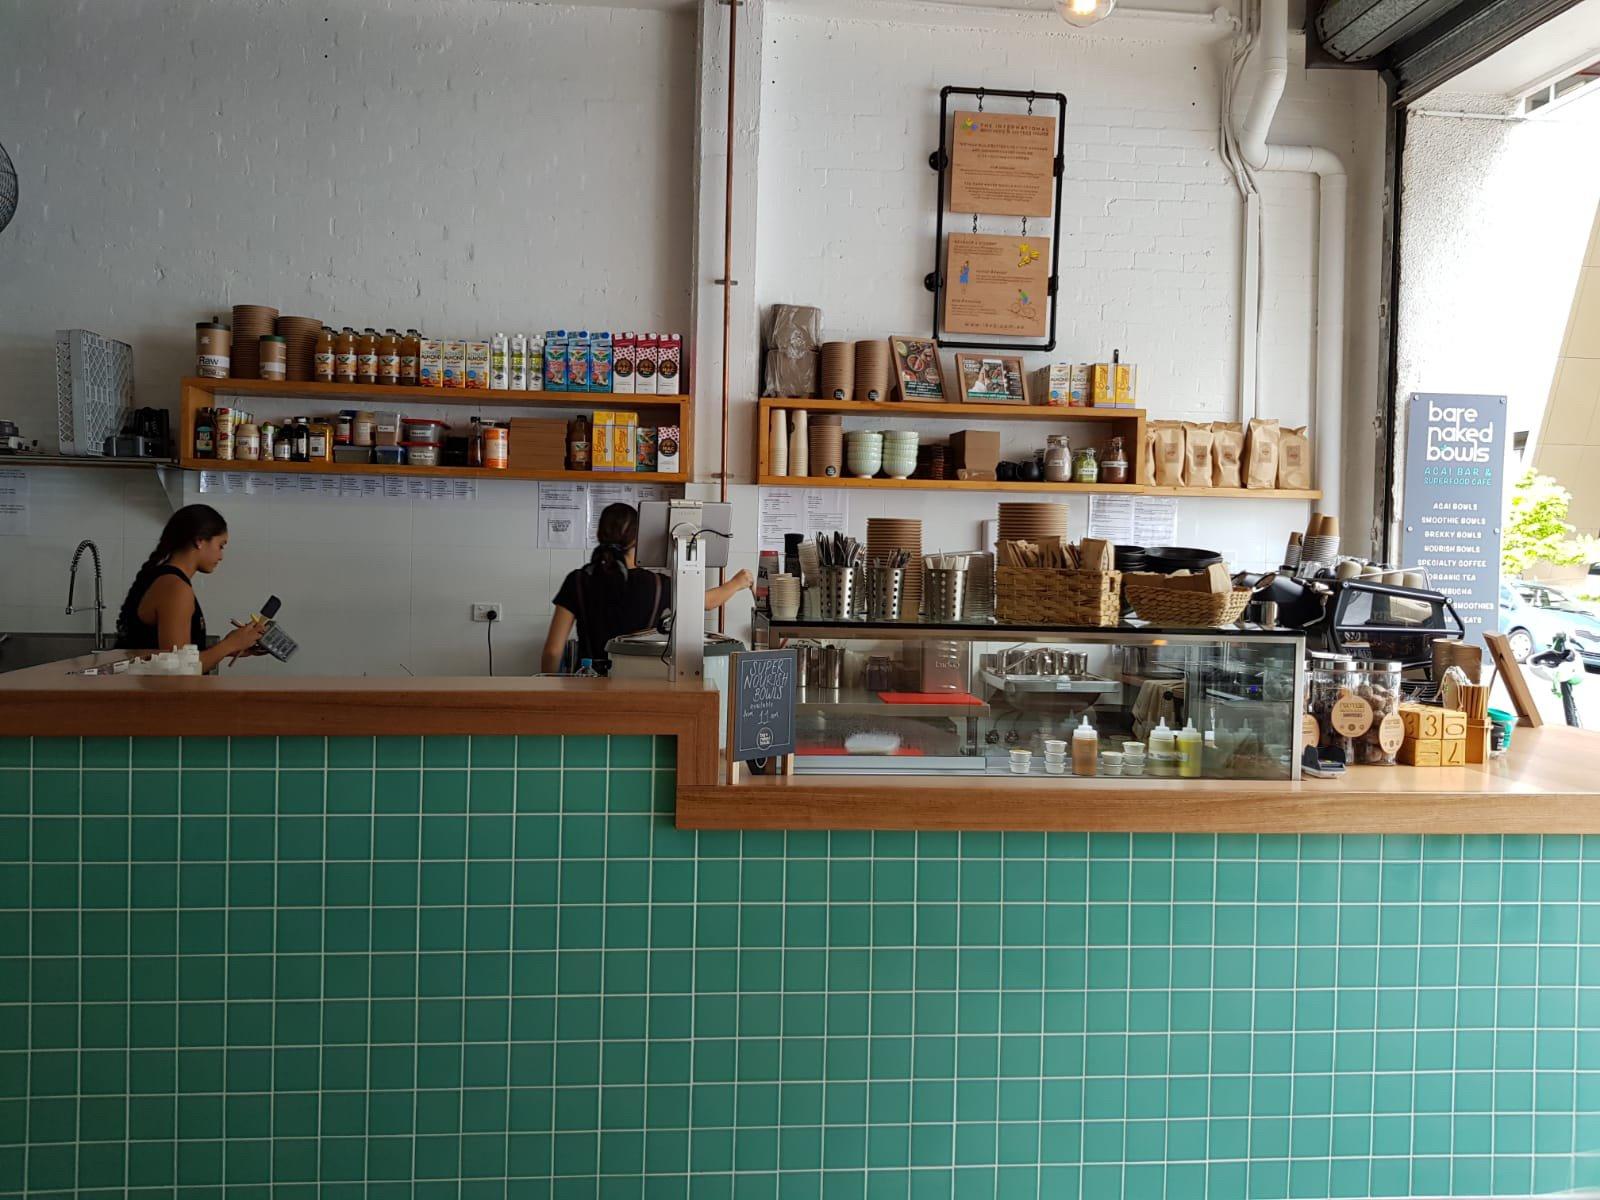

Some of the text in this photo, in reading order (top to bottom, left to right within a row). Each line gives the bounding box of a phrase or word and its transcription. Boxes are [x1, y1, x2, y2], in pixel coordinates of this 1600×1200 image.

[199, 355, 219, 366] Raw
[1428, 400, 1478, 422] bare
[1427, 421, 1494, 443] naked
[1426, 445, 1490, 462] bowls
[1424, 467, 1492, 476] ACAI BAR &
[1424, 477, 1469, 485] SUPERFOOD
[1452, 503, 1478, 511] BOWLS
[1421, 516, 1486, 525] SMOOTHIE BOWLS
[1424, 530, 1482, 539] BREKKY BOWLS
[1424, 545, 1481, 553] NOURISH BOWLS
[1417, 559, 1487, 568] SPECIALTY COFFEE
[1427, 573, 1460, 581] ORGANIC
[750, 659, 784, 676] SUPER
[743, 671, 789, 690] NOURISH
[752, 685, 783, 703] BOWLS
[1424, 714, 1437, 737] 3
